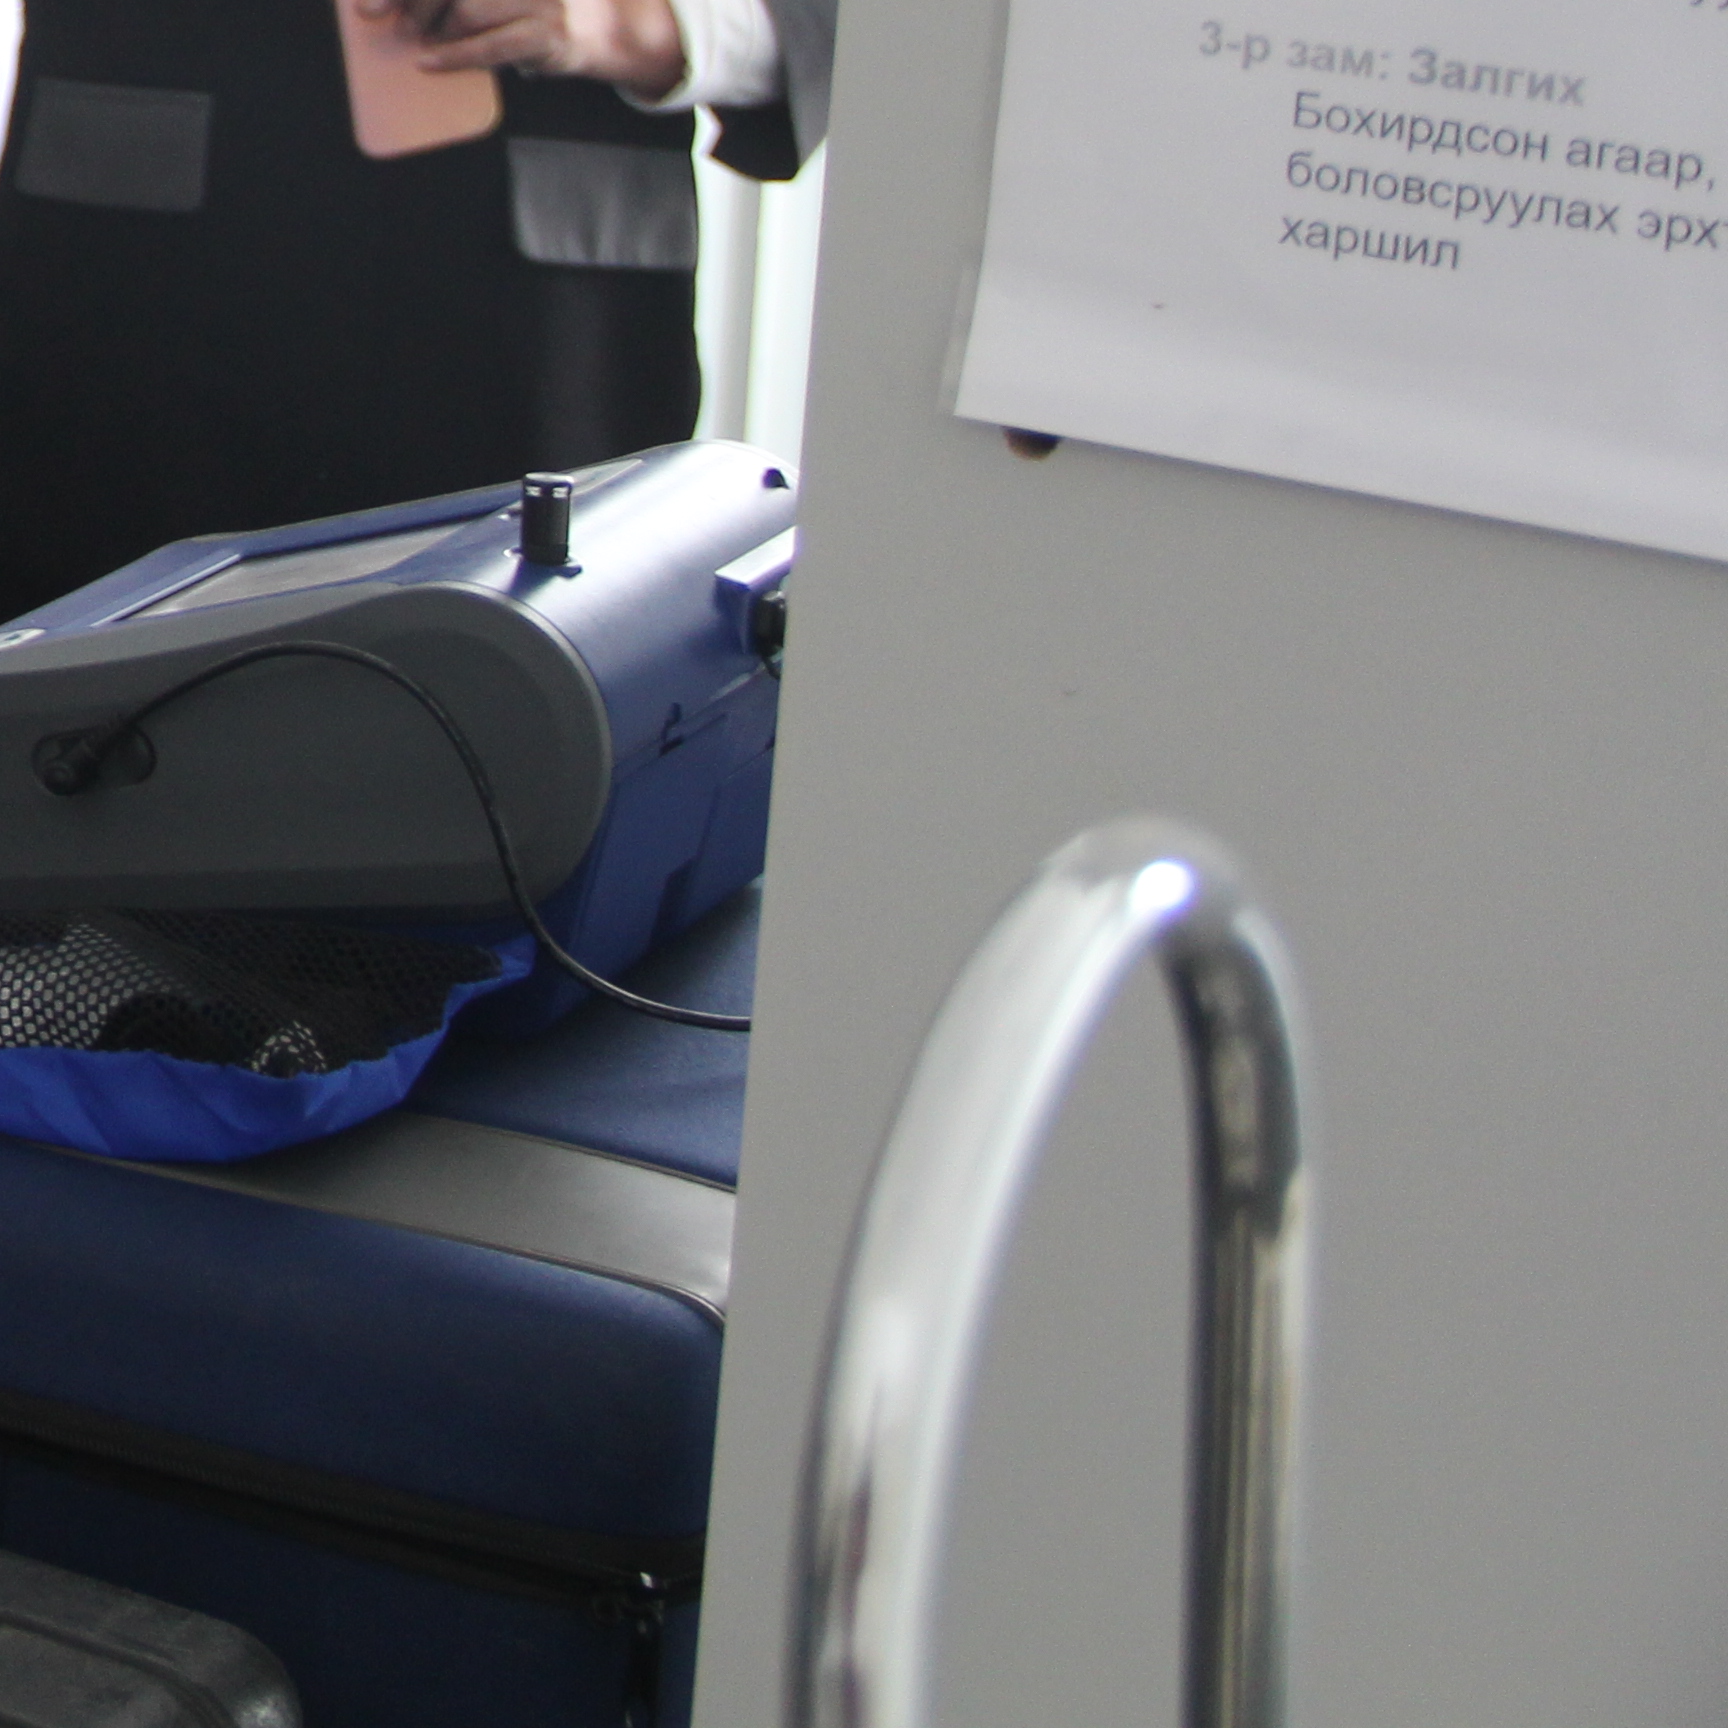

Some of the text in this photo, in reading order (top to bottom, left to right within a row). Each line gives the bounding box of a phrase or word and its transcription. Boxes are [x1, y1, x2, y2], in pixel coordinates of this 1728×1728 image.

[1199, 20, 1587, 106] 3-р зам: Залгих
[1292, 90, 1716, 192] Бохирдсон агаар,
[1278, 216, 1462, 271] харшил
[1286, 150, 1728, 253] боловсруулах эрх
